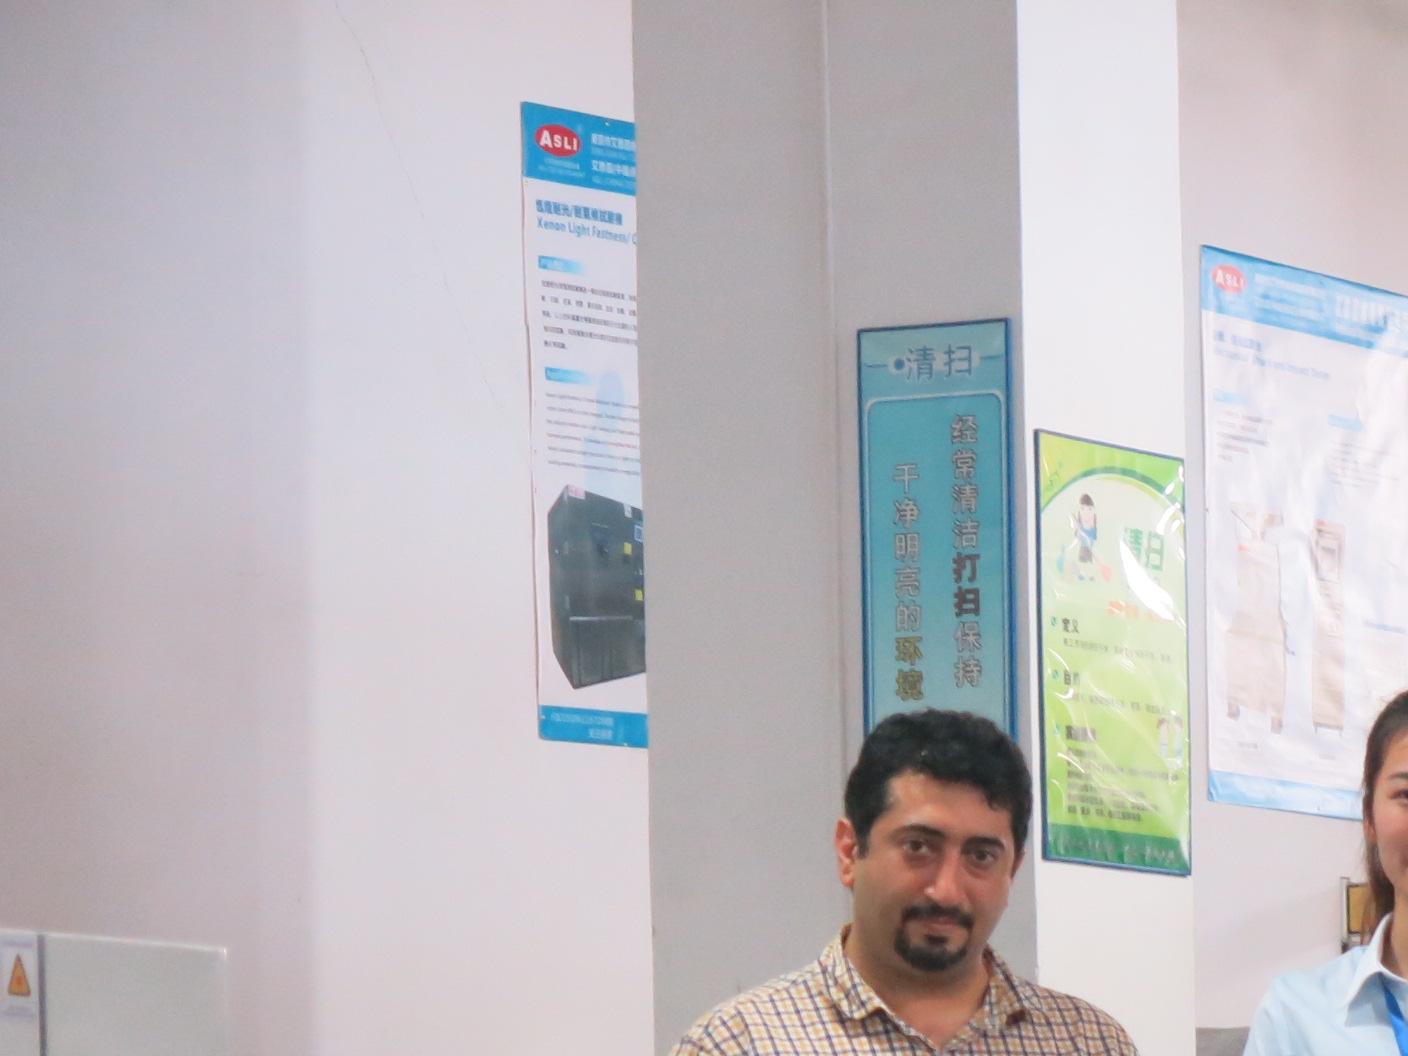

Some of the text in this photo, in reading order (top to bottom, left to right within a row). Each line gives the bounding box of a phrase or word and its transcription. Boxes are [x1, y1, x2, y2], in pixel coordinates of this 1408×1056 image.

[540, 129, 578, 151] ASLI
[537, 216, 566, 231] Xenon
[568, 221, 590, 239] Light
[905, 344, 973, 381] 清扫
[951, 413, 982, 688] 经常清洁打扫保持
[893, 463, 924, 701] 干净明亮的环境
